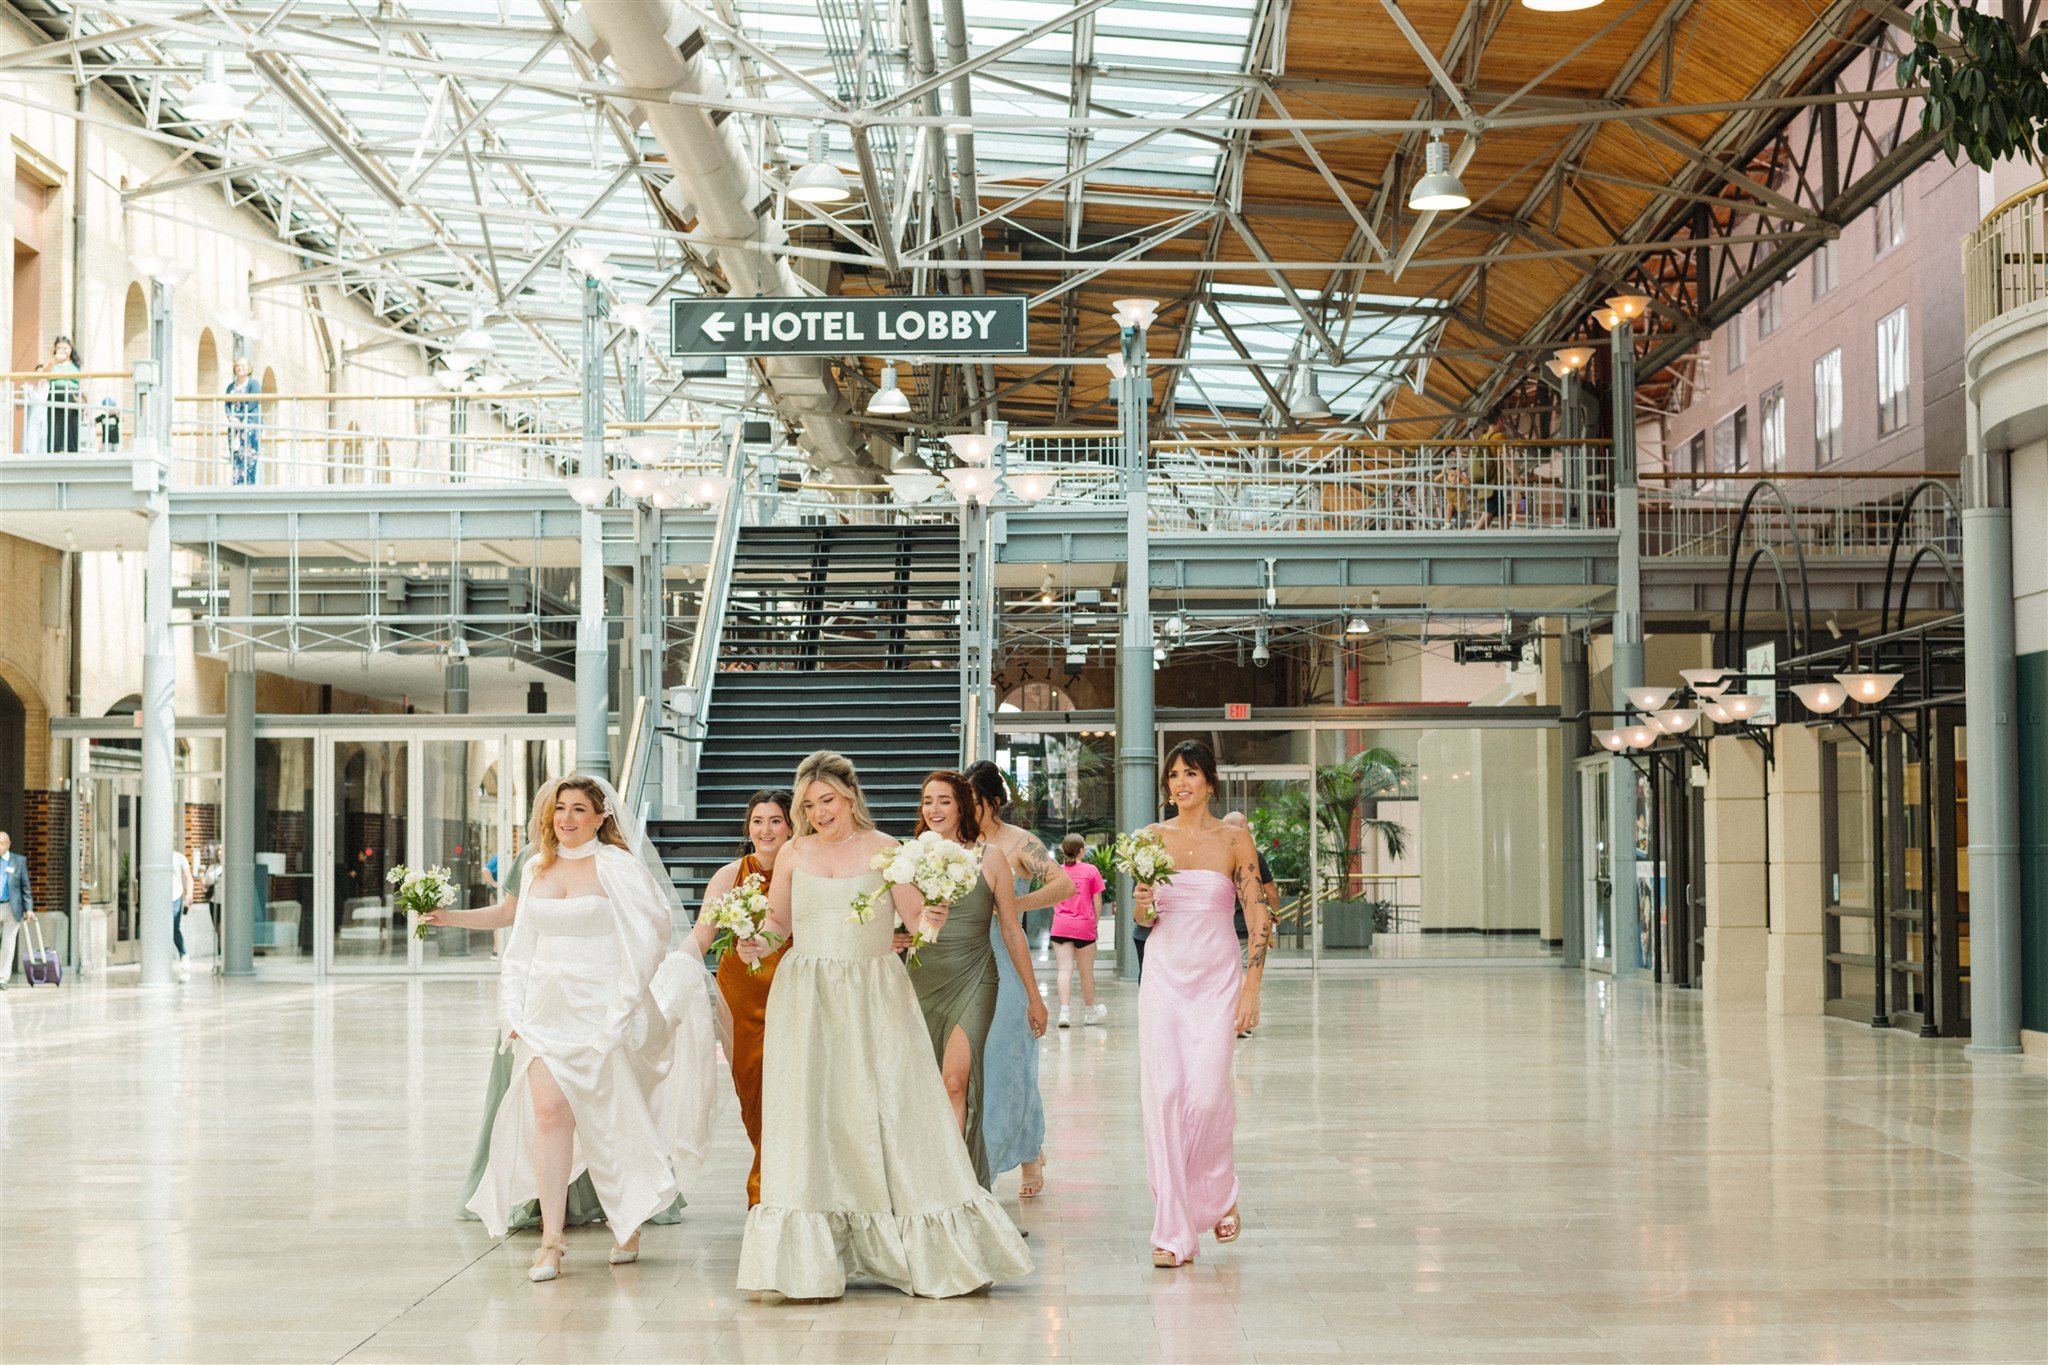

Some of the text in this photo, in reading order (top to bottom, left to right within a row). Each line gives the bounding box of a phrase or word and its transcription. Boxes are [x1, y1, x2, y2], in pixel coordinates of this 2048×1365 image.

[743, 310, 997, 342] HOTEL LOBBY
[177, 590, 230, 598] MIDWAY ITE
[993, 662, 1081, 693] EXIT
[1229, 704, 1248, 718] EXIT
